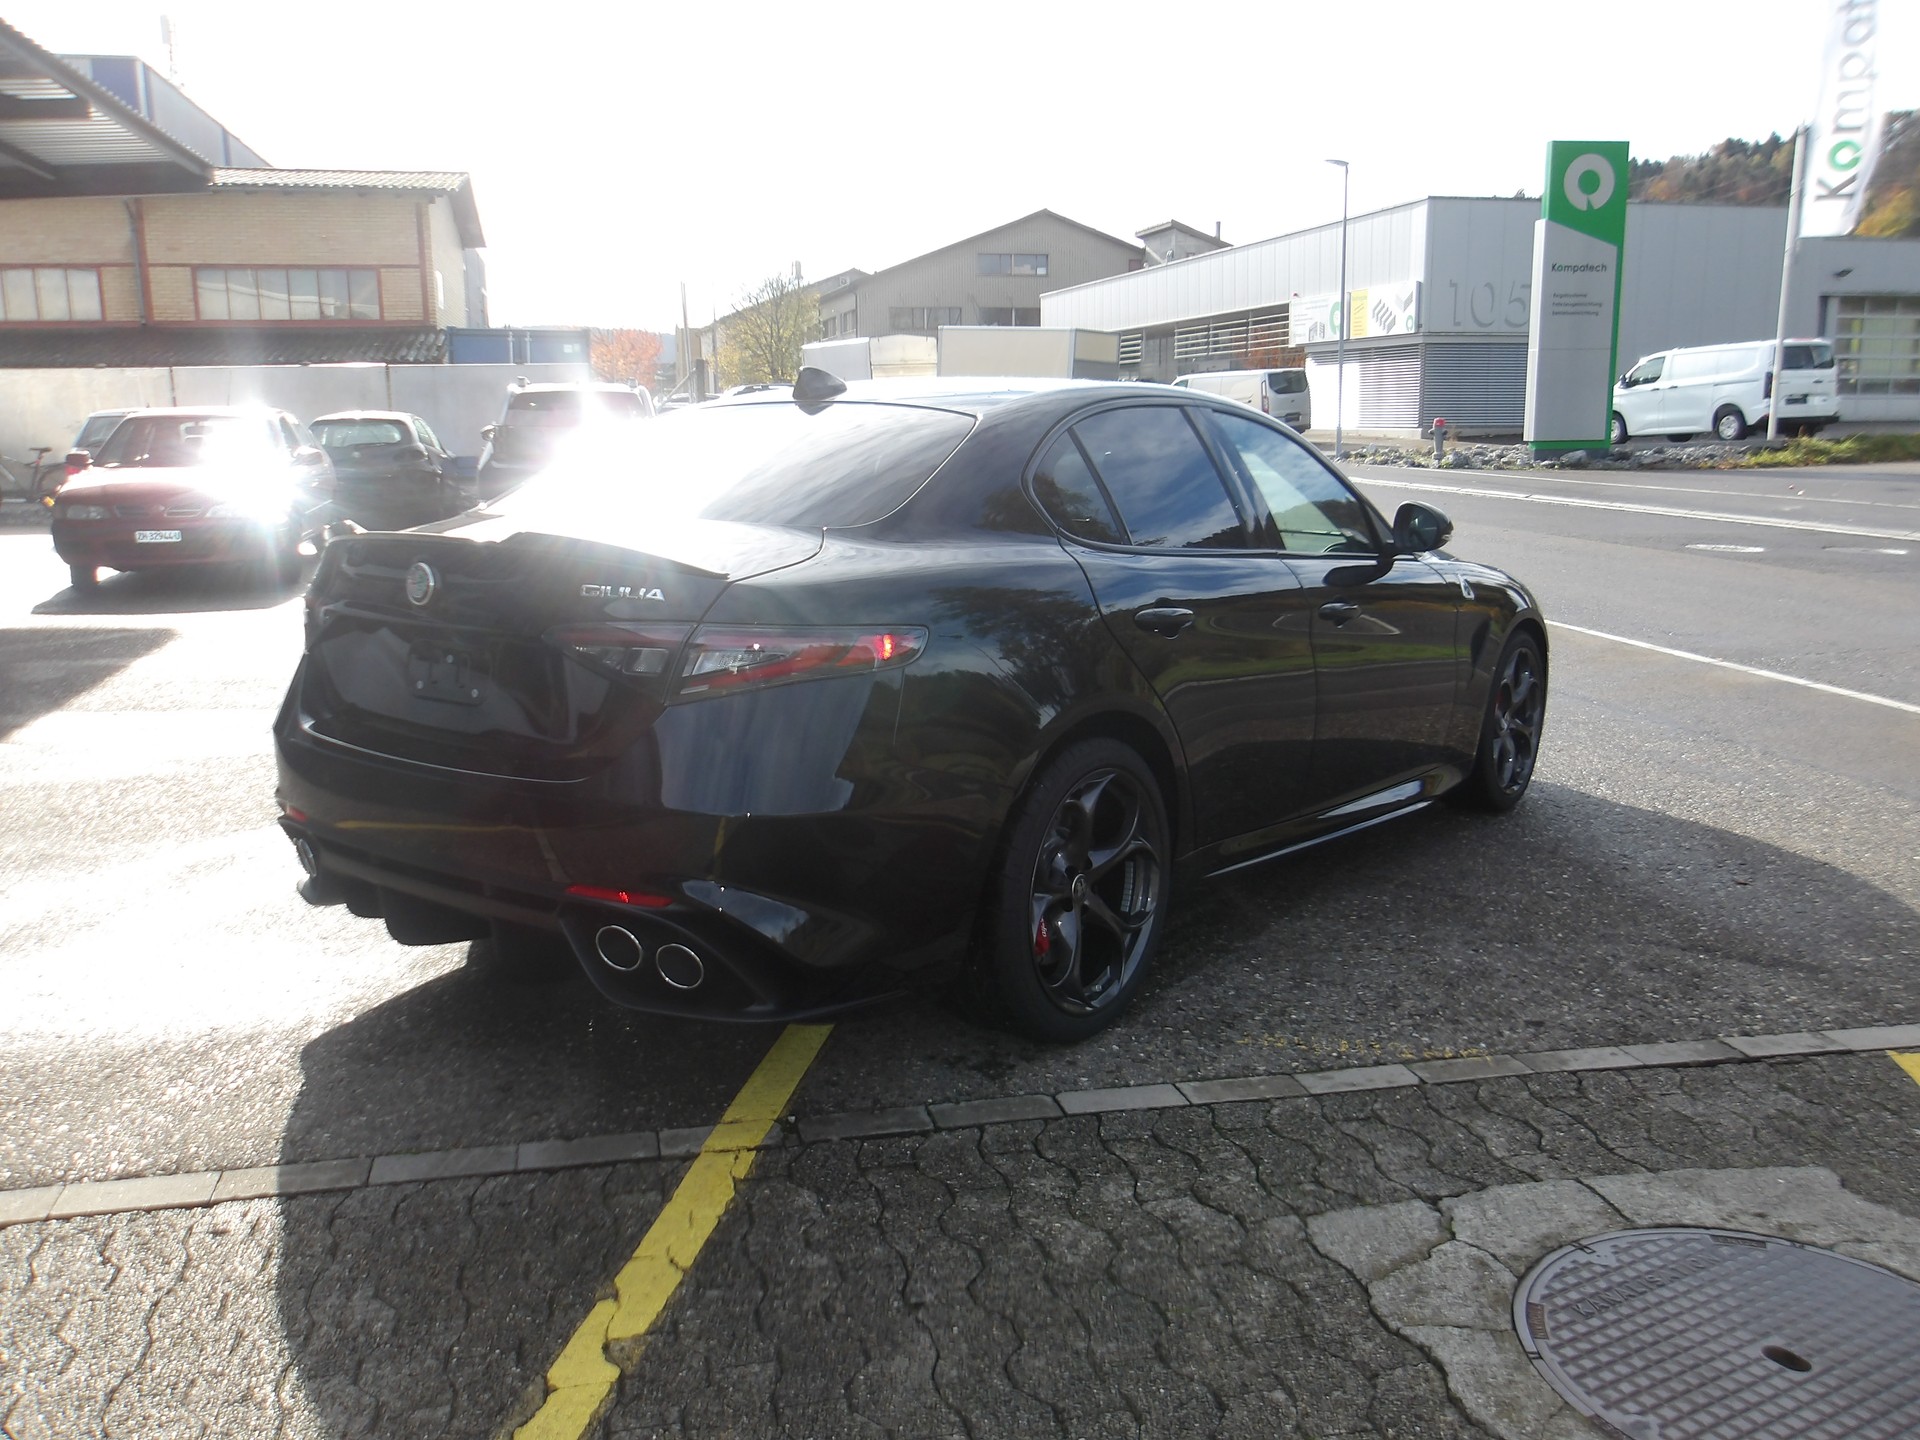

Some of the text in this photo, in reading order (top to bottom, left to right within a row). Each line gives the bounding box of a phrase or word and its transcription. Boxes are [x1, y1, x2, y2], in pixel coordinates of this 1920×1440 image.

[1551, 262, 1607, 274] Kompatech
[1449, 279, 1531, 328] 105
[580, 584, 665, 601] GIULIA
